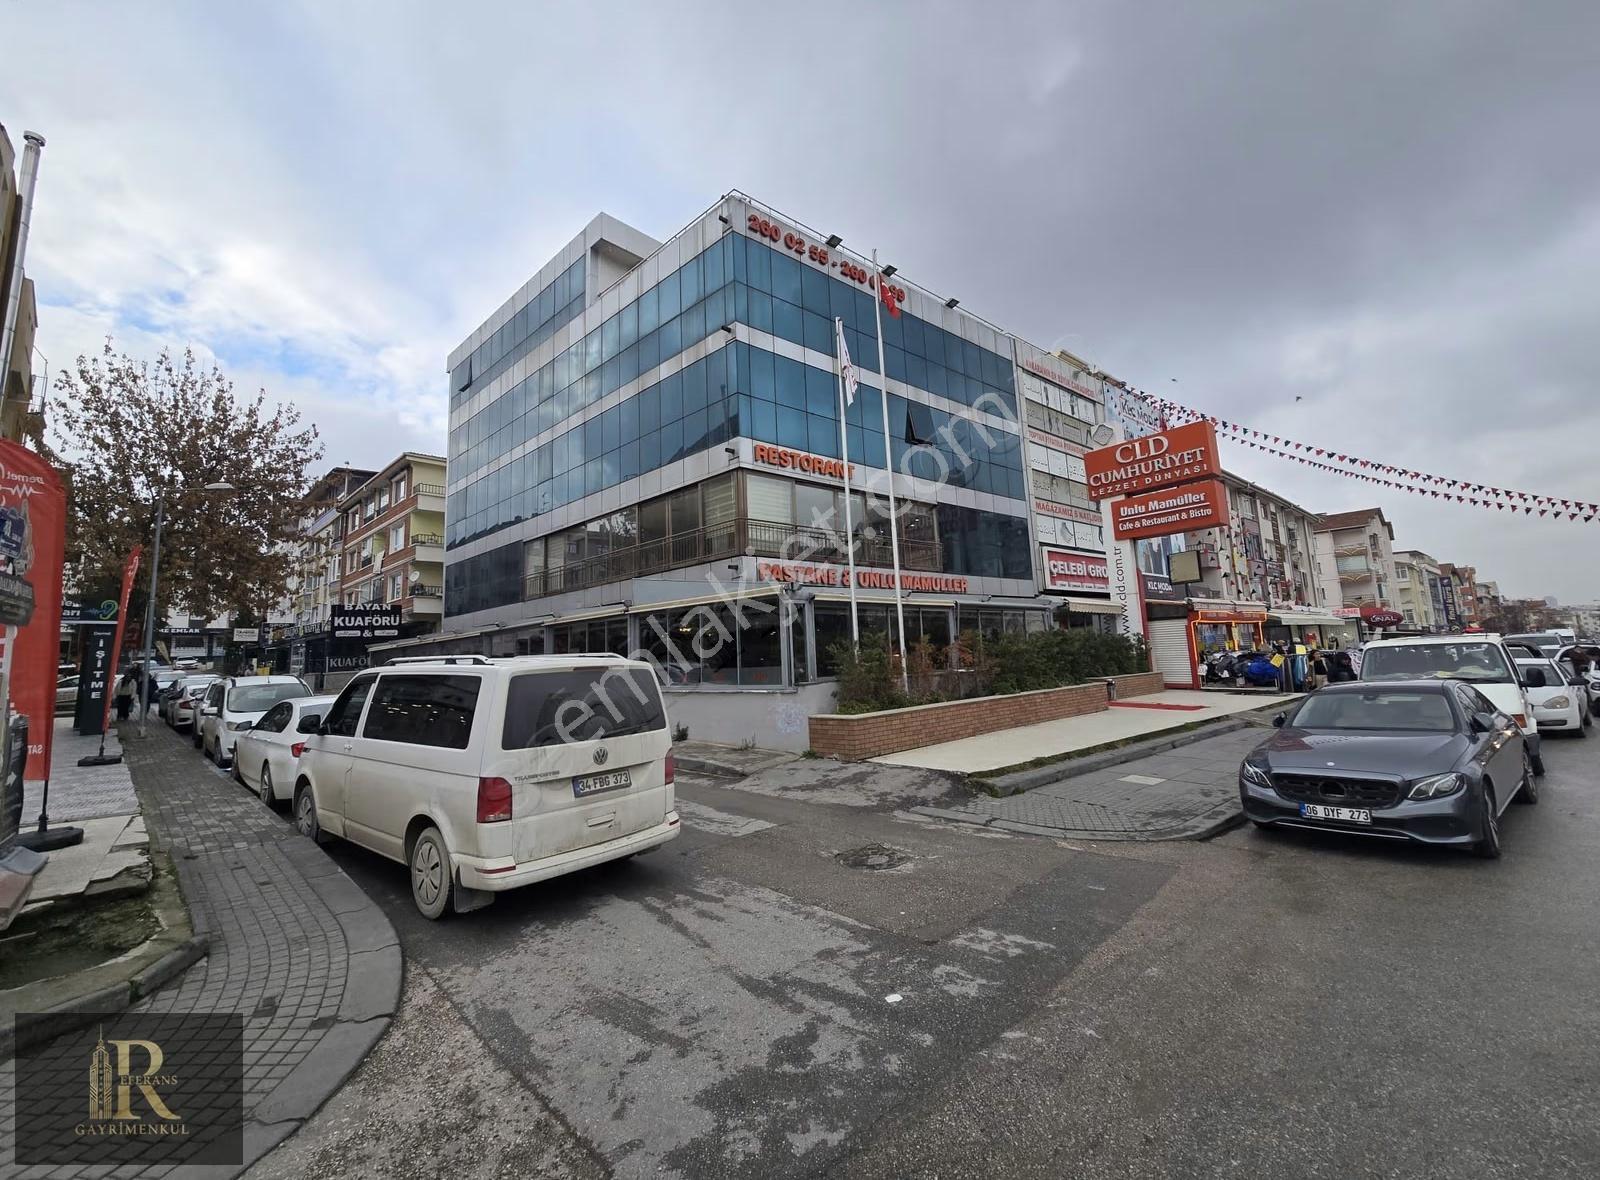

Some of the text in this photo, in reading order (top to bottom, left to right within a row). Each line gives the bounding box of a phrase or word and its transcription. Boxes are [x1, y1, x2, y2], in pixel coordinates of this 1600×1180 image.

[748, 214, 781, 242] 260
[784, 232, 806, 255] 02
[808, 244, 829, 265] 55
[840, 260, 867, 284] 260
[1115, 436, 1169, 463] CLD
[754, 444, 855, 480] RESTORANT
[1089, 447, 1205, 487] CUMHURİYET
[1091, 464, 1208, 497] LEZZET DÜNYASI
[1120, 493, 1206, 517] Unlu Mamüller
[1119, 520, 1134, 532] Cafe
[1135, 520, 1141, 528] &
[1142, 514, 1180, 527] Restaurant
[1189, 508, 1212, 518] Bistro
[758, 562, 838, 585] PASTANE
[1049, 561, 1087, 577] ÇELEBİ
[1113, 546, 1131, 637] www.cld.com.tr
[334, 614, 400, 626] KUAFÖRÜ
[578, 772, 629, 791] 34 FBG 373
[1306, 805, 1369, 820] 06 DYF 273
